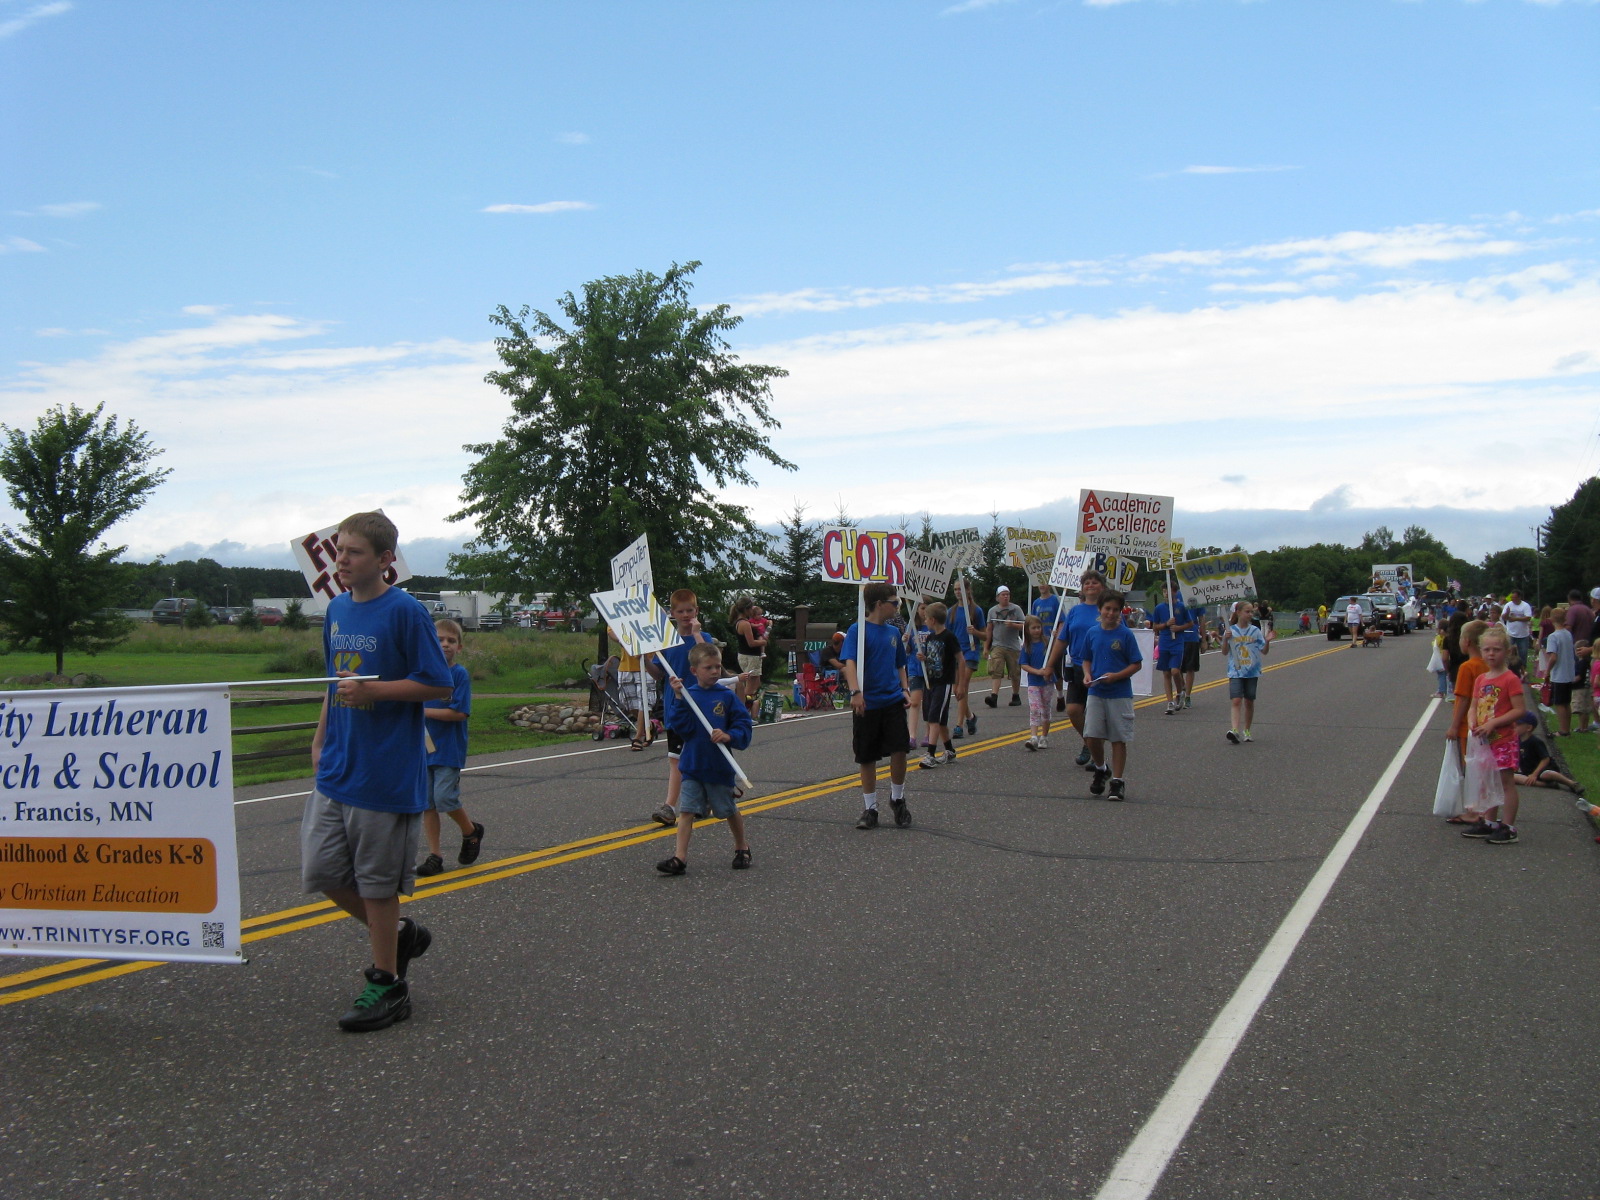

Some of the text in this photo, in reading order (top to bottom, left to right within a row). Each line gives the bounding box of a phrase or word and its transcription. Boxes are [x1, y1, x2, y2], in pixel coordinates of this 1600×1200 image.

[1081, 490, 1161, 513] Academic
[1082, 513, 1166, 534] Excellence
[931, 530, 980, 550] Athletics
[1084, 544, 1161, 558] HIGHER THAN AVERAGE
[1089, 535, 1117, 545] TESTING
[1132, 536, 1157, 548] GRADES
[613, 545, 647, 585] Computer
[823, 530, 905, 585] CHOIR
[909, 551, 947, 575] CARING
[1057, 547, 1087, 569] Chapel
[1182, 558, 1247, 580] Little Lambs
[1192, 585, 1221, 596] DAYCARE
[597, 597, 649, 619] LATCH
[629, 620, 664, 642] KEY
[42, 699, 208, 736] Lutheran
[54, 753, 81, 789] &
[93, 750, 221, 790] School
[14, 801, 153, 826] Francis, MN
[73, 844, 89, 864] &
[97, 844, 162, 864] Grades
[169, 845, 204, 864] K-8
[11, 882, 86, 902] Christian
[93, 885, 179, 904] Education
